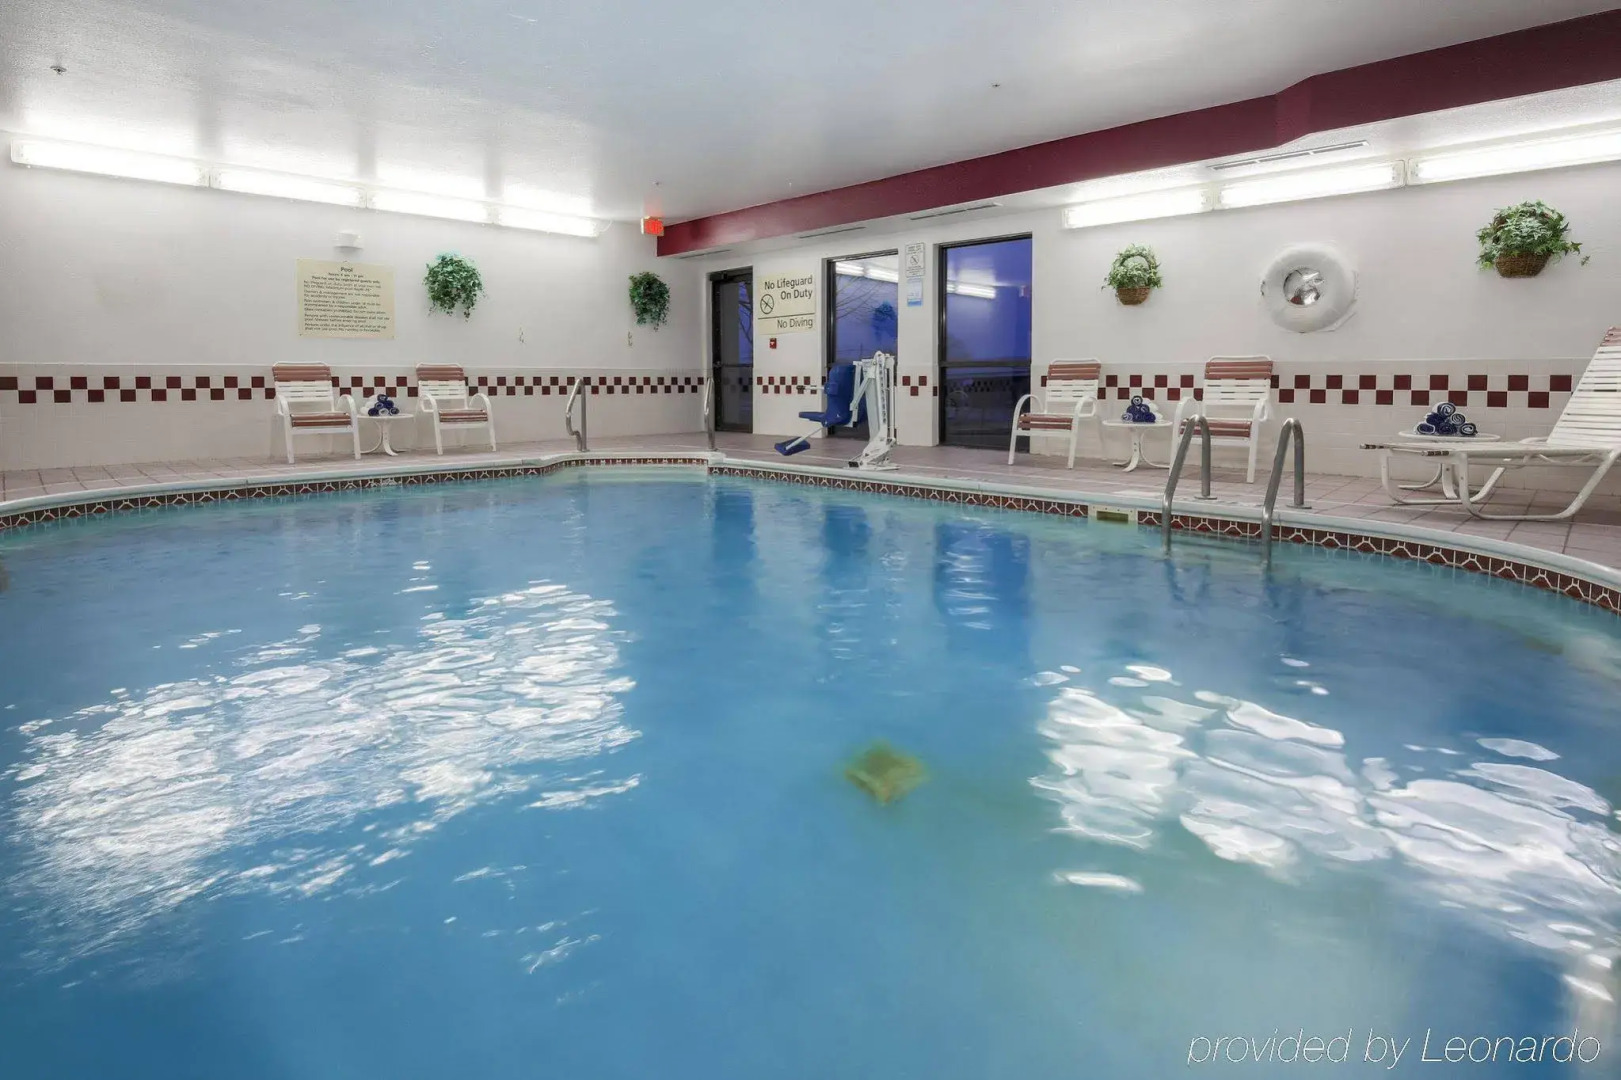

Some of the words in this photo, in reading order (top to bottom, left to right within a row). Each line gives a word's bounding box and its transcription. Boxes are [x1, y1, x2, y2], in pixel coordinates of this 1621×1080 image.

[764, 281, 775, 290] No
[777, 275, 813, 289] Lifeguard
[780, 290, 791, 300] On
[793, 289, 813, 300] Duty
[777, 319, 787, 328] No
[789, 317, 813, 329] Diving
